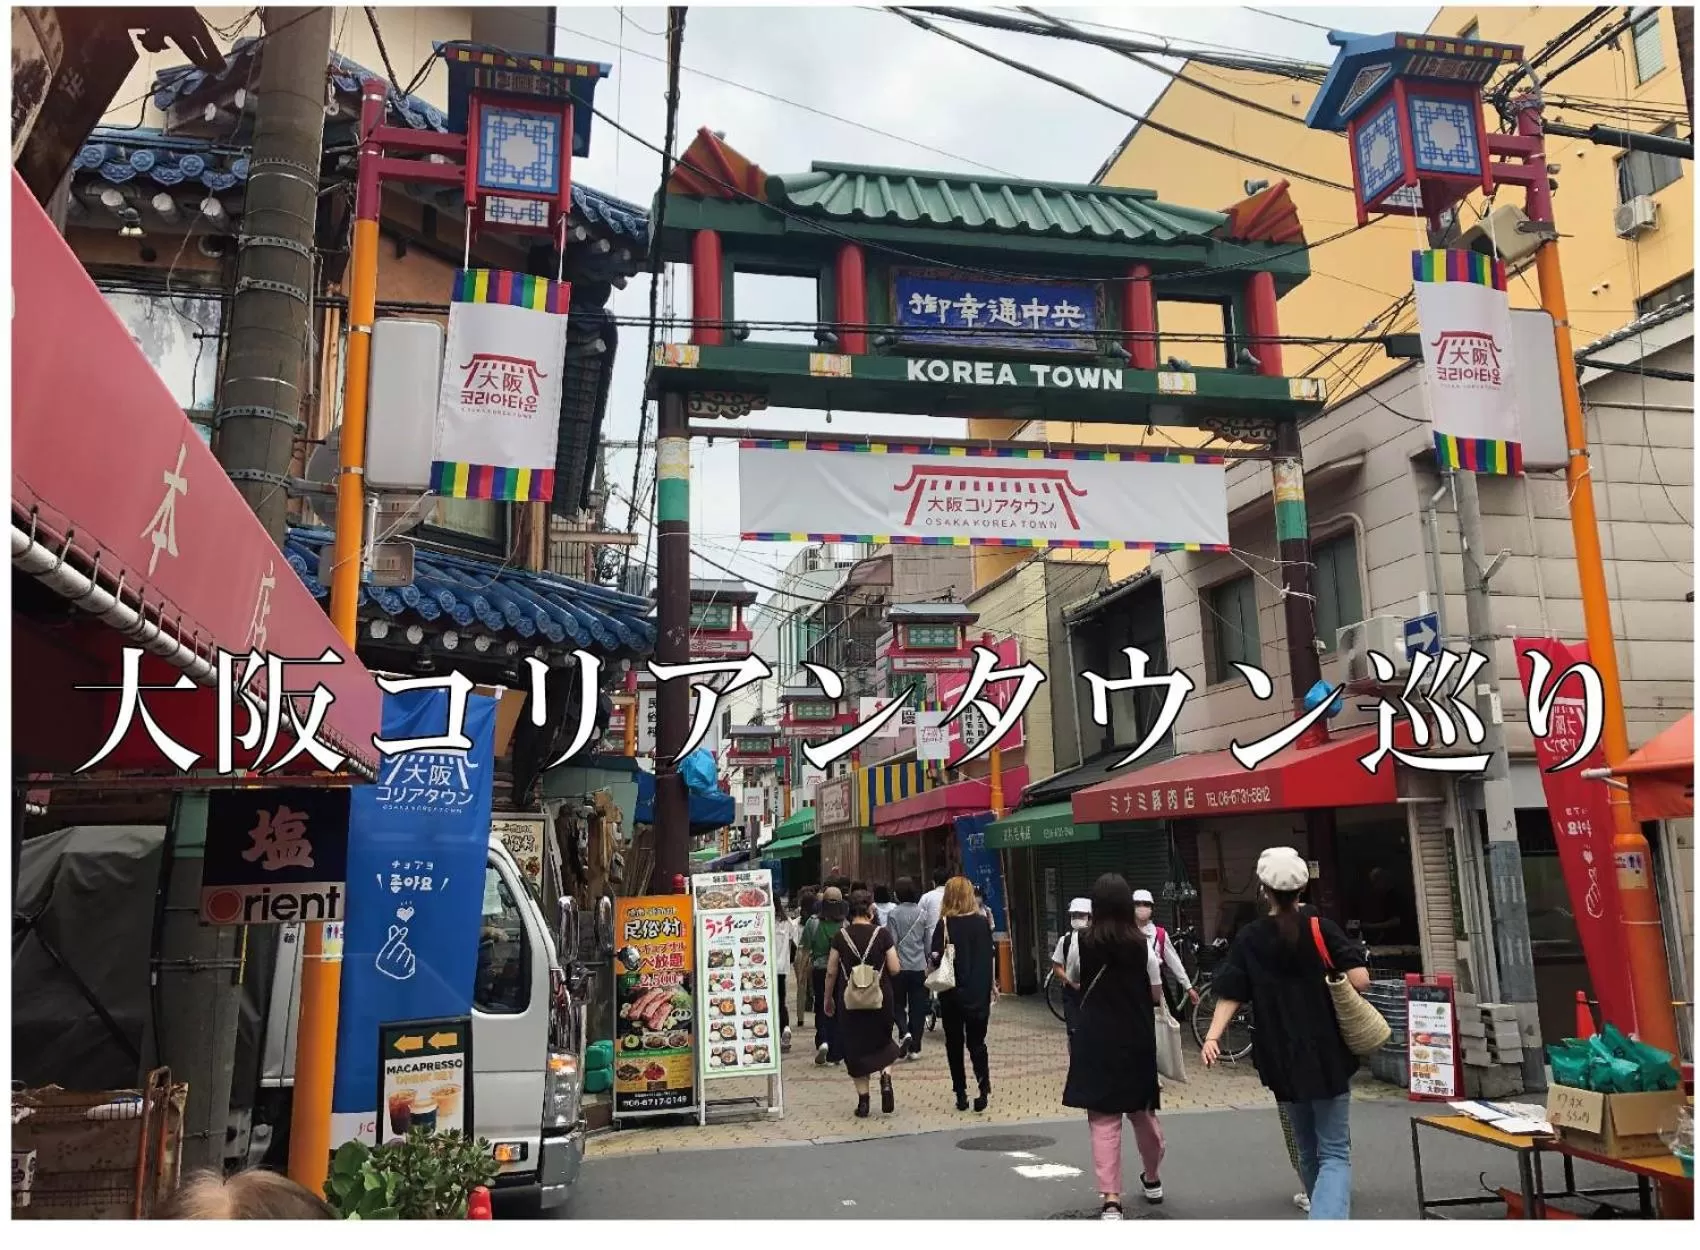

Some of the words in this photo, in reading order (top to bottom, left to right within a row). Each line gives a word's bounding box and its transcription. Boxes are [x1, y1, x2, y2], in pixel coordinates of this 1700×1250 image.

[908, 292, 1086, 330] 御幸通中央
[1449, 346, 1489, 366] 大阪
[477, 370, 523, 394] 大阪
[907, 359, 1018, 386] KOREA
[1029, 364, 1123, 390] TOWN
[1437, 366, 1502, 386] 코리아타운
[460, 390, 538, 413] 코리아타운
[926, 495, 1056, 516] 大阪コリアタウン
[925, 517, 969, 527] OSAKA
[402, 763, 454, 786] 大阪
[376, 786, 474, 805] コリアタウン
[389, 873, 433, 894] 좋아요
[386, 1058, 464, 1075] MACAPRESSO
